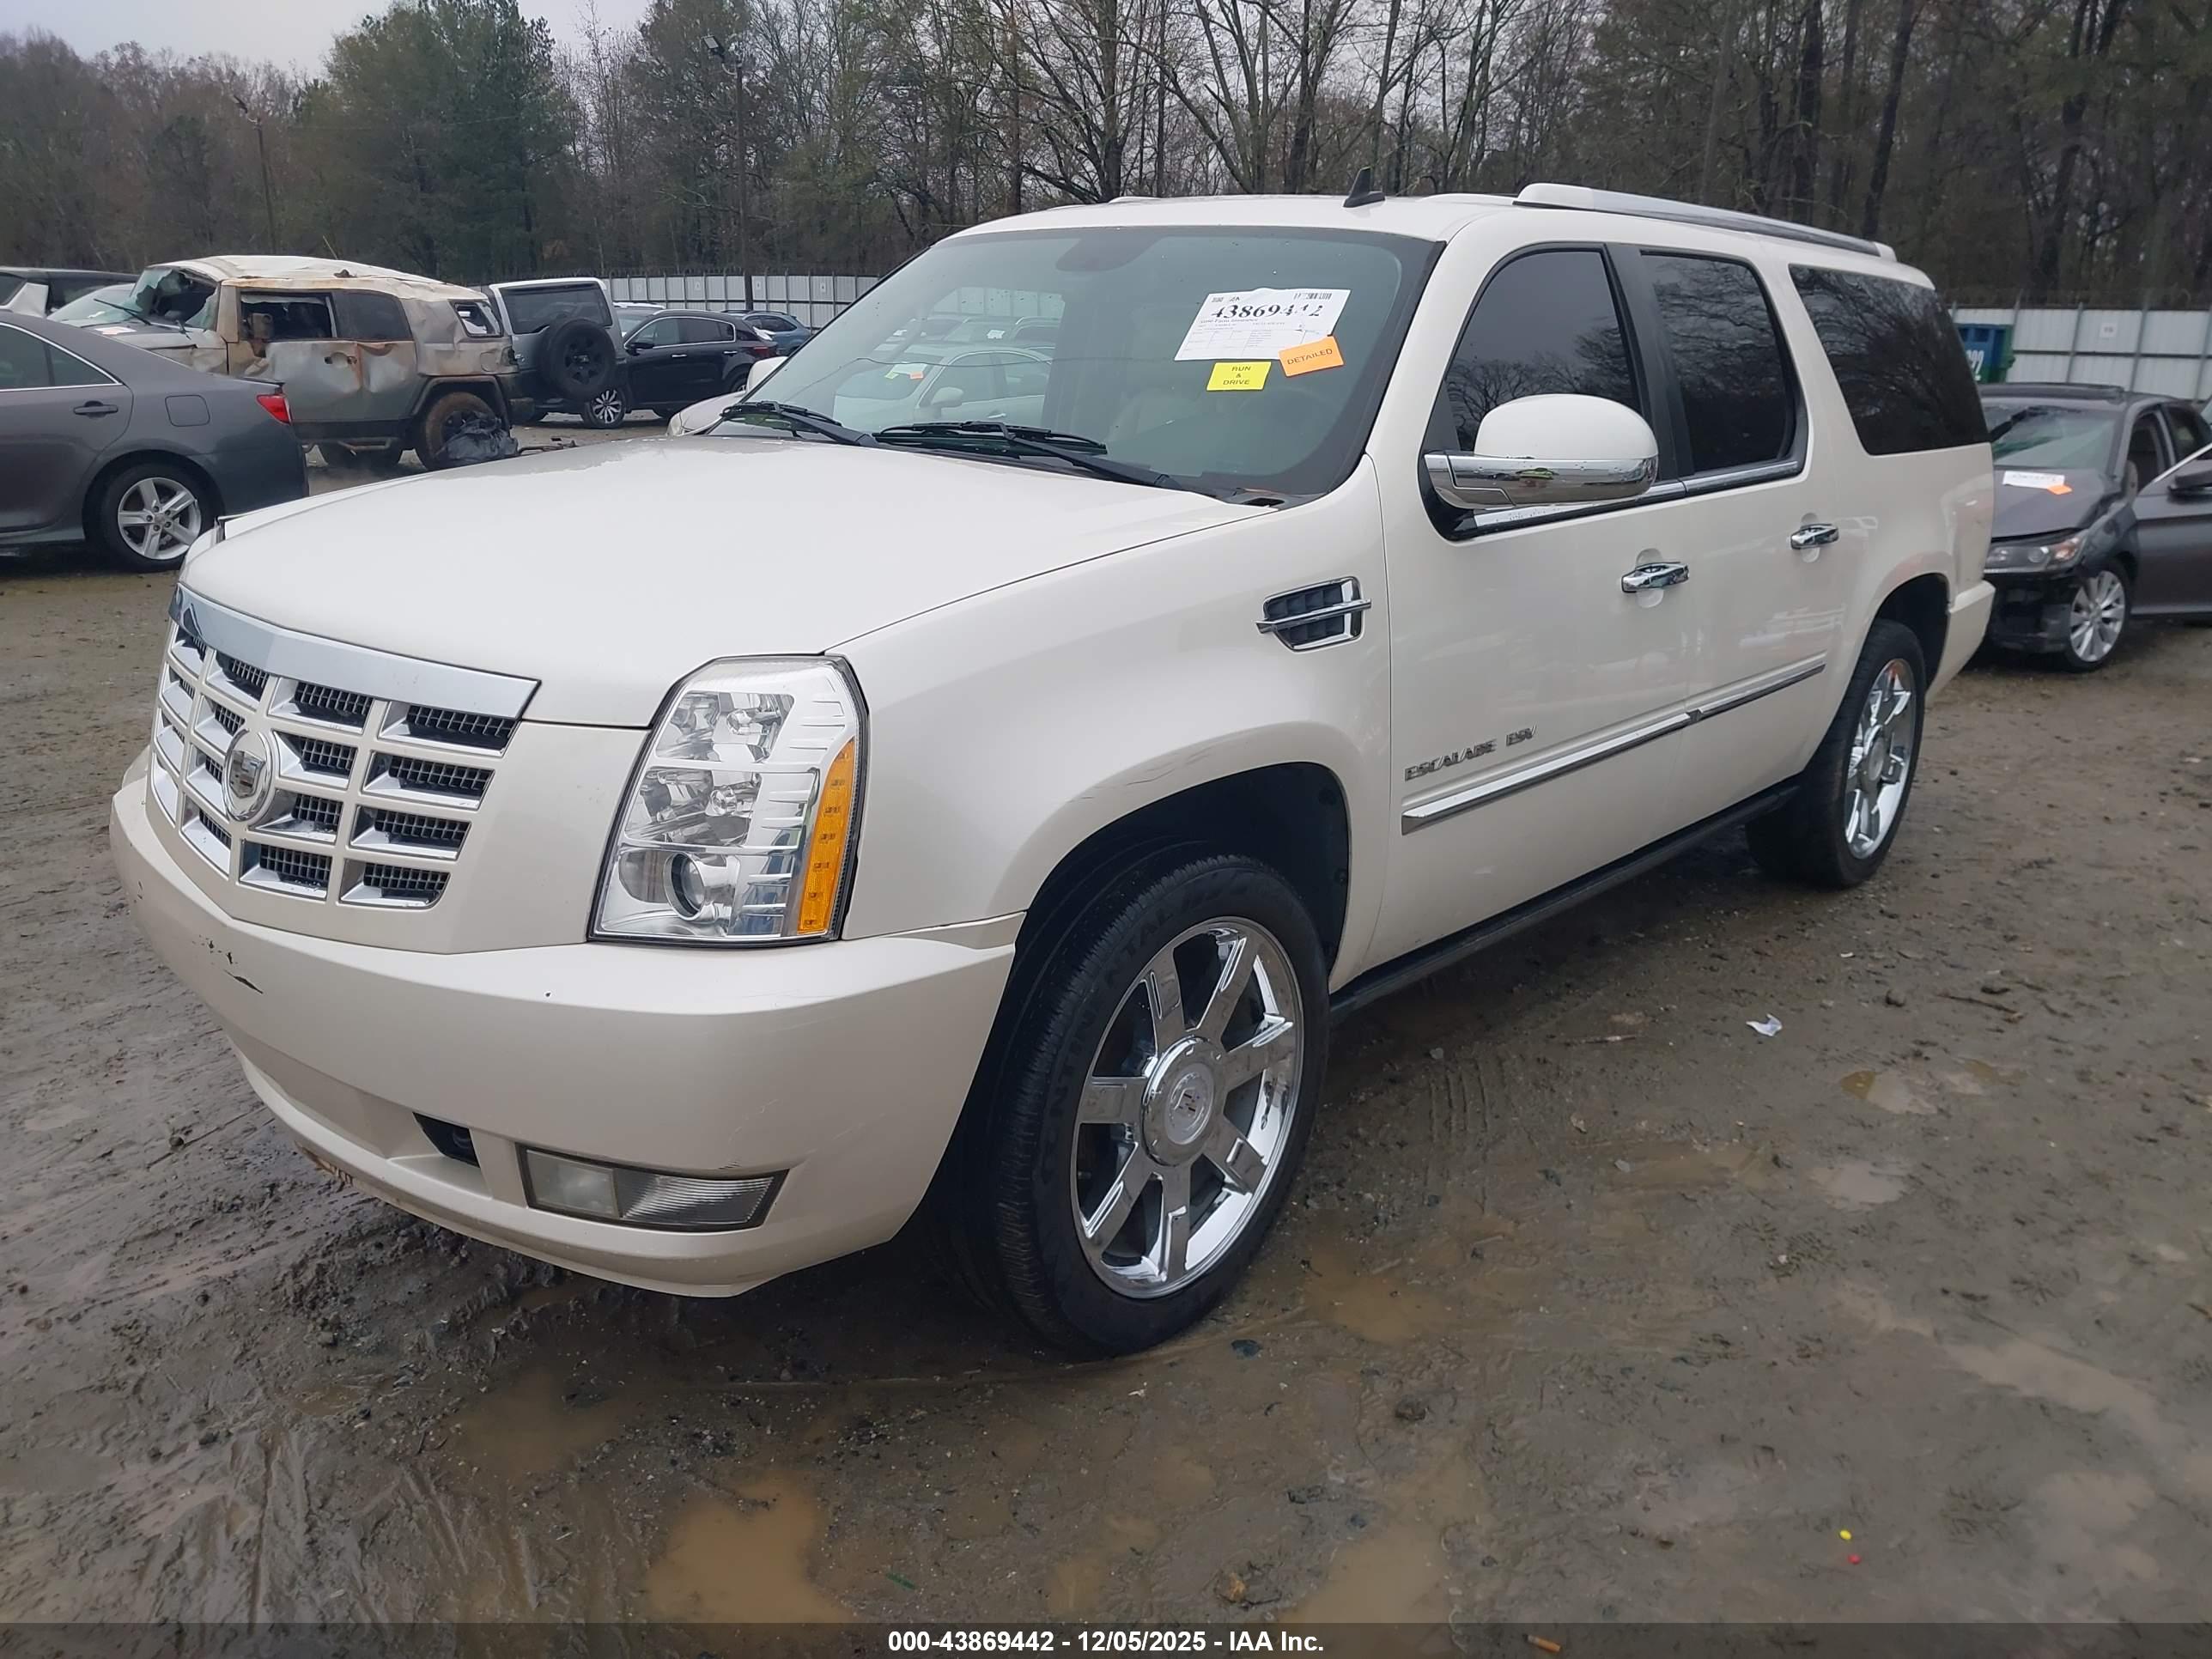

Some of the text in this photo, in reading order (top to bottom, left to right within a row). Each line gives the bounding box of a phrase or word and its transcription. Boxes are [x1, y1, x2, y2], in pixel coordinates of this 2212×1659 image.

[1287, 348, 1333, 364] DETAILED
[1405, 721, 1537, 781] ESCALADE ESV
